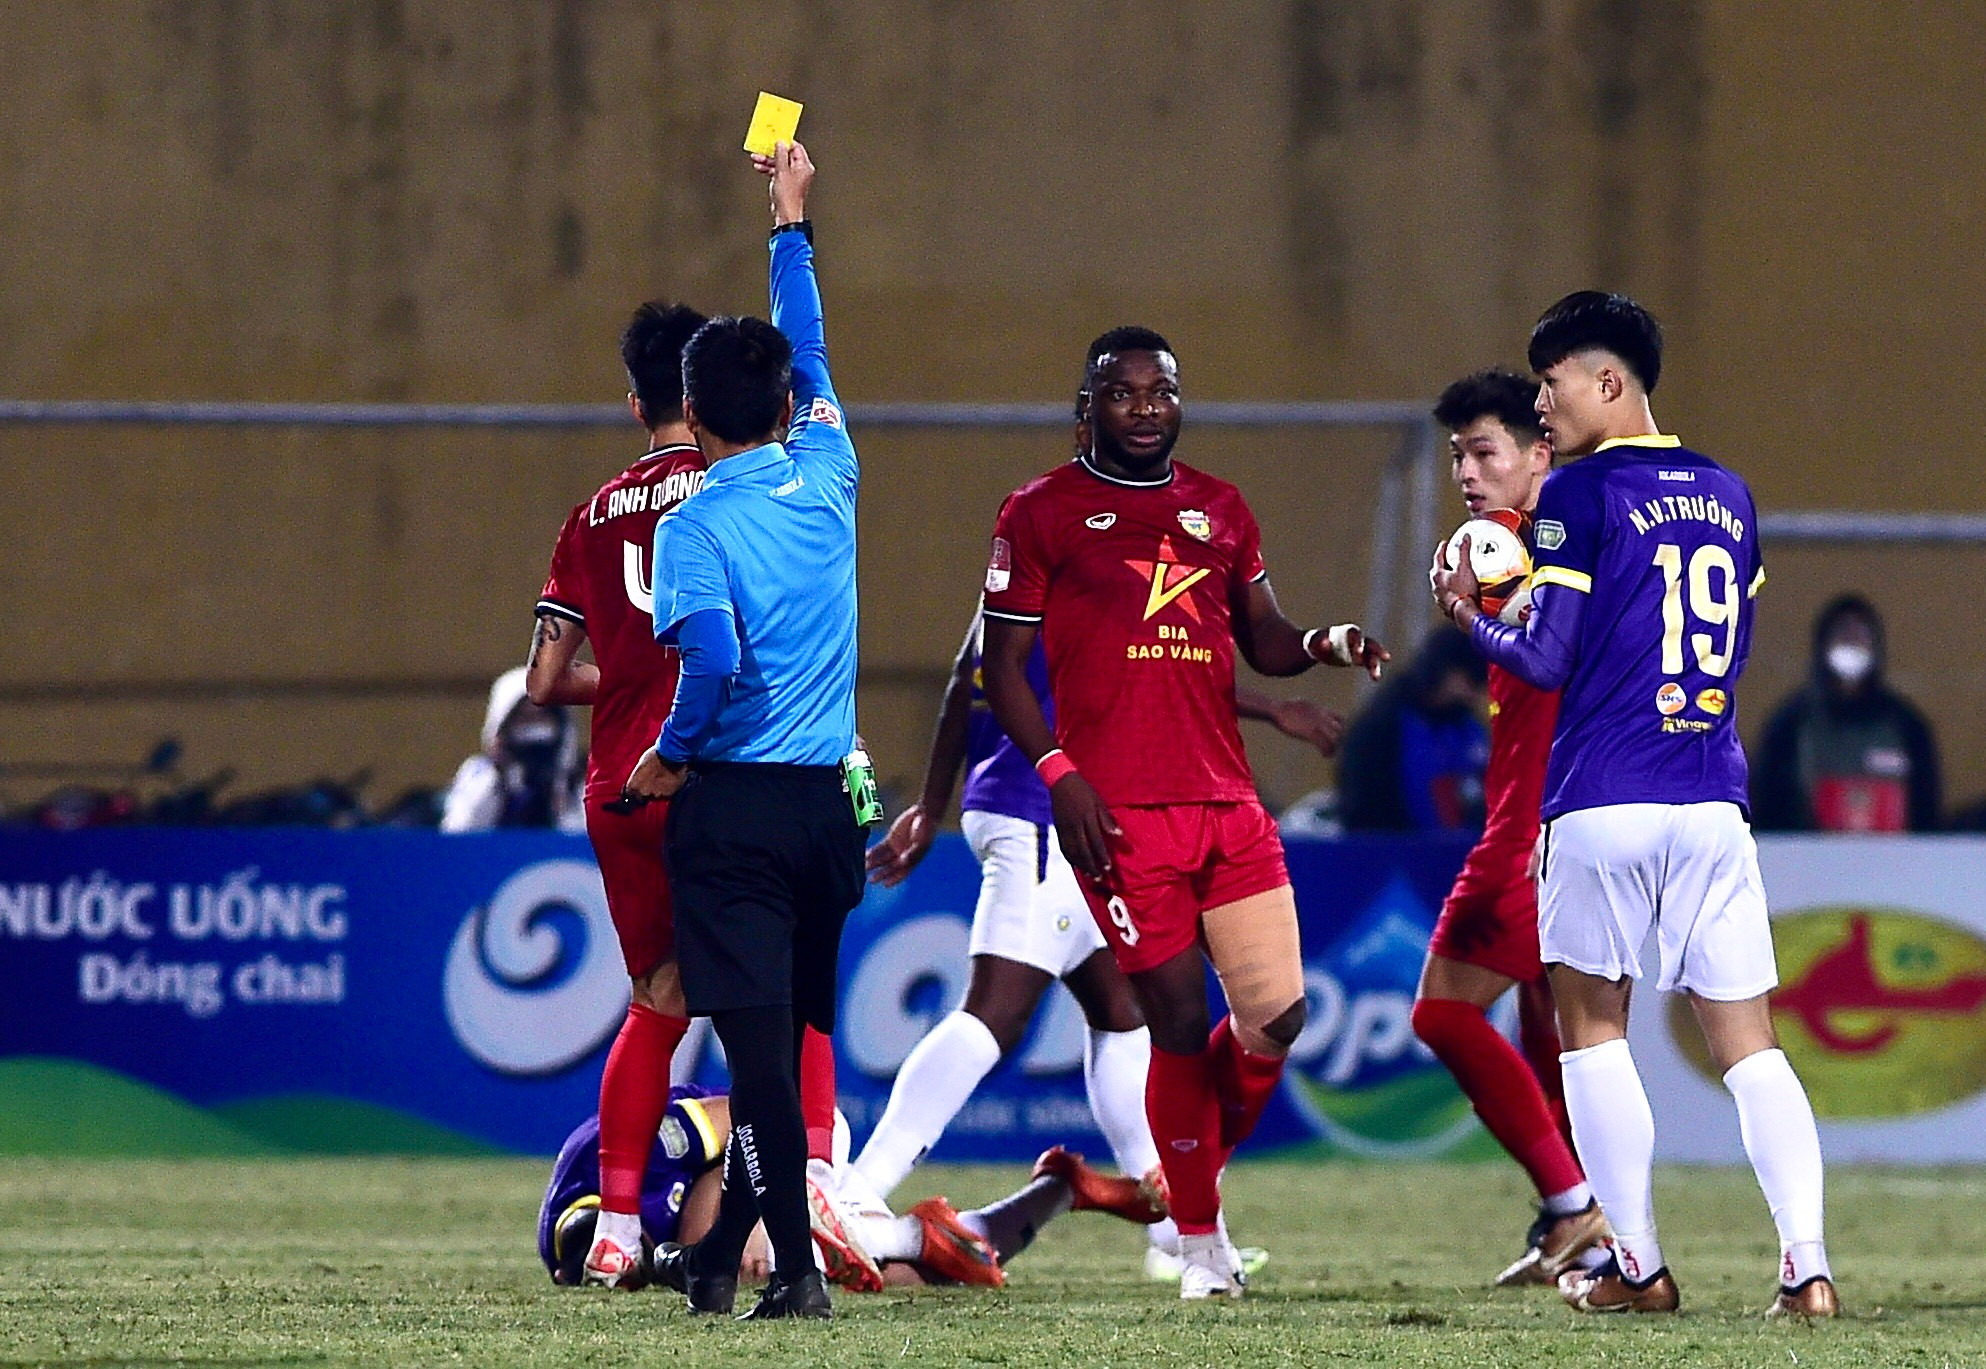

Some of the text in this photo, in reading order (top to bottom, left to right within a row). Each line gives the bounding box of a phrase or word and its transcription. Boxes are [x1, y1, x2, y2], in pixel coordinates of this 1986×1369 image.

[589, 498, 605, 527] L.
[607, 485, 649, 519] ANH
[1158, 625, 1189, 641] BIA
[1652, 544, 1740, 677] 19
[1126, 642, 1213, 663] SAO VÀNG
[168, 864, 348, 940] UỐNG
[1107, 894, 1141, 948] 9
[231, 951, 346, 1003] chai
[735, 1123, 767, 1197] JOGARBOLA
